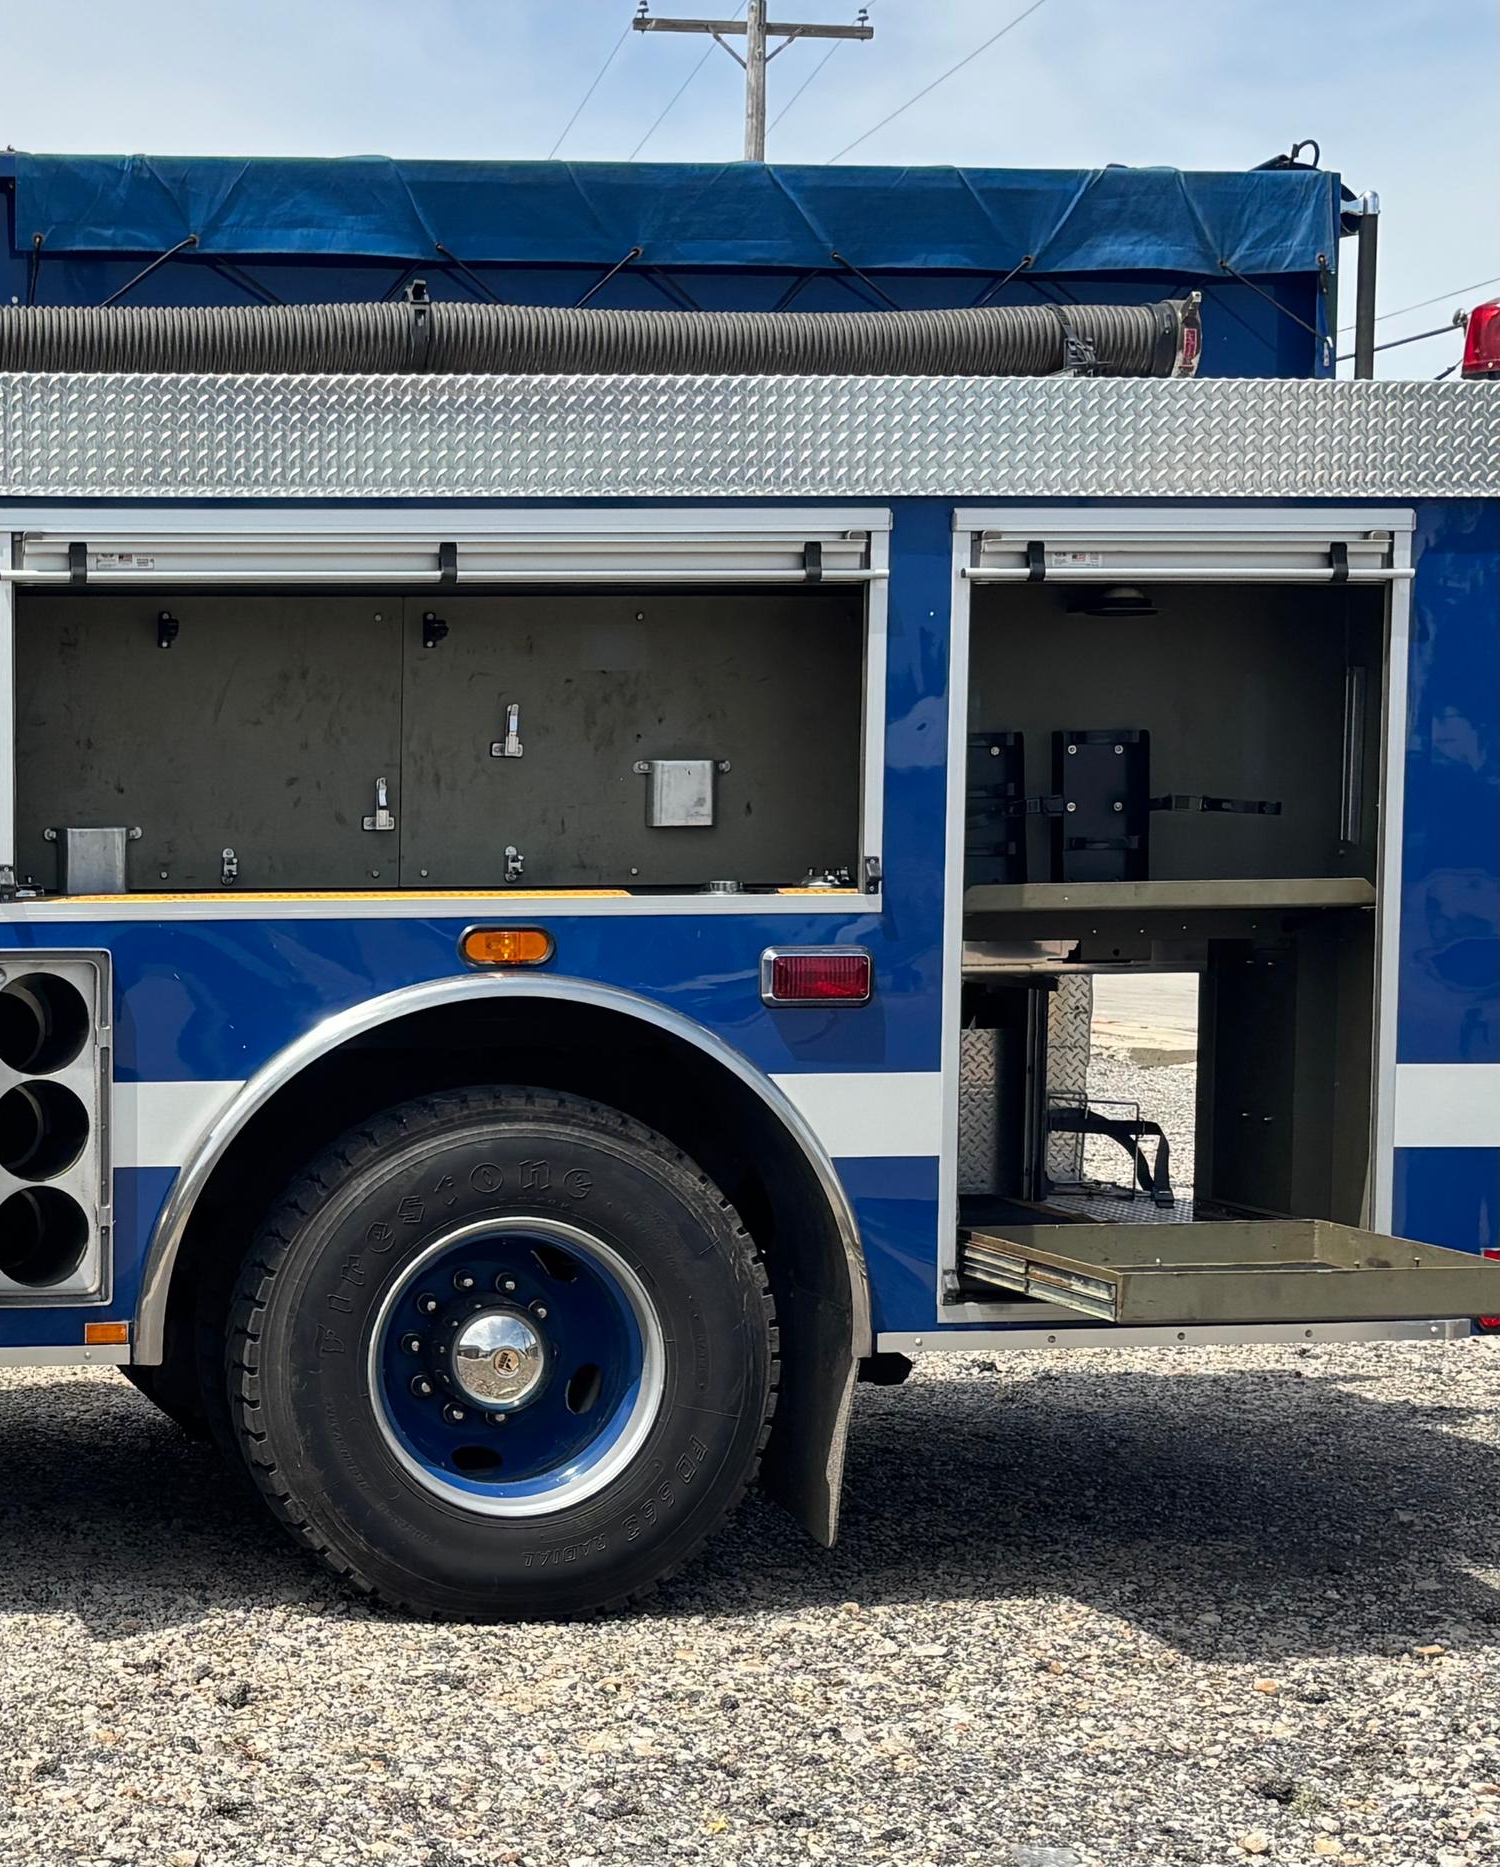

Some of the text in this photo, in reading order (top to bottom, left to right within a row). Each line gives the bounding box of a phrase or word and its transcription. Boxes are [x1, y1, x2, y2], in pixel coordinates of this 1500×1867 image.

[318, 1160, 594, 1354] Firestone
[523, 1434, 708, 1567] FD 663 RADIAL
